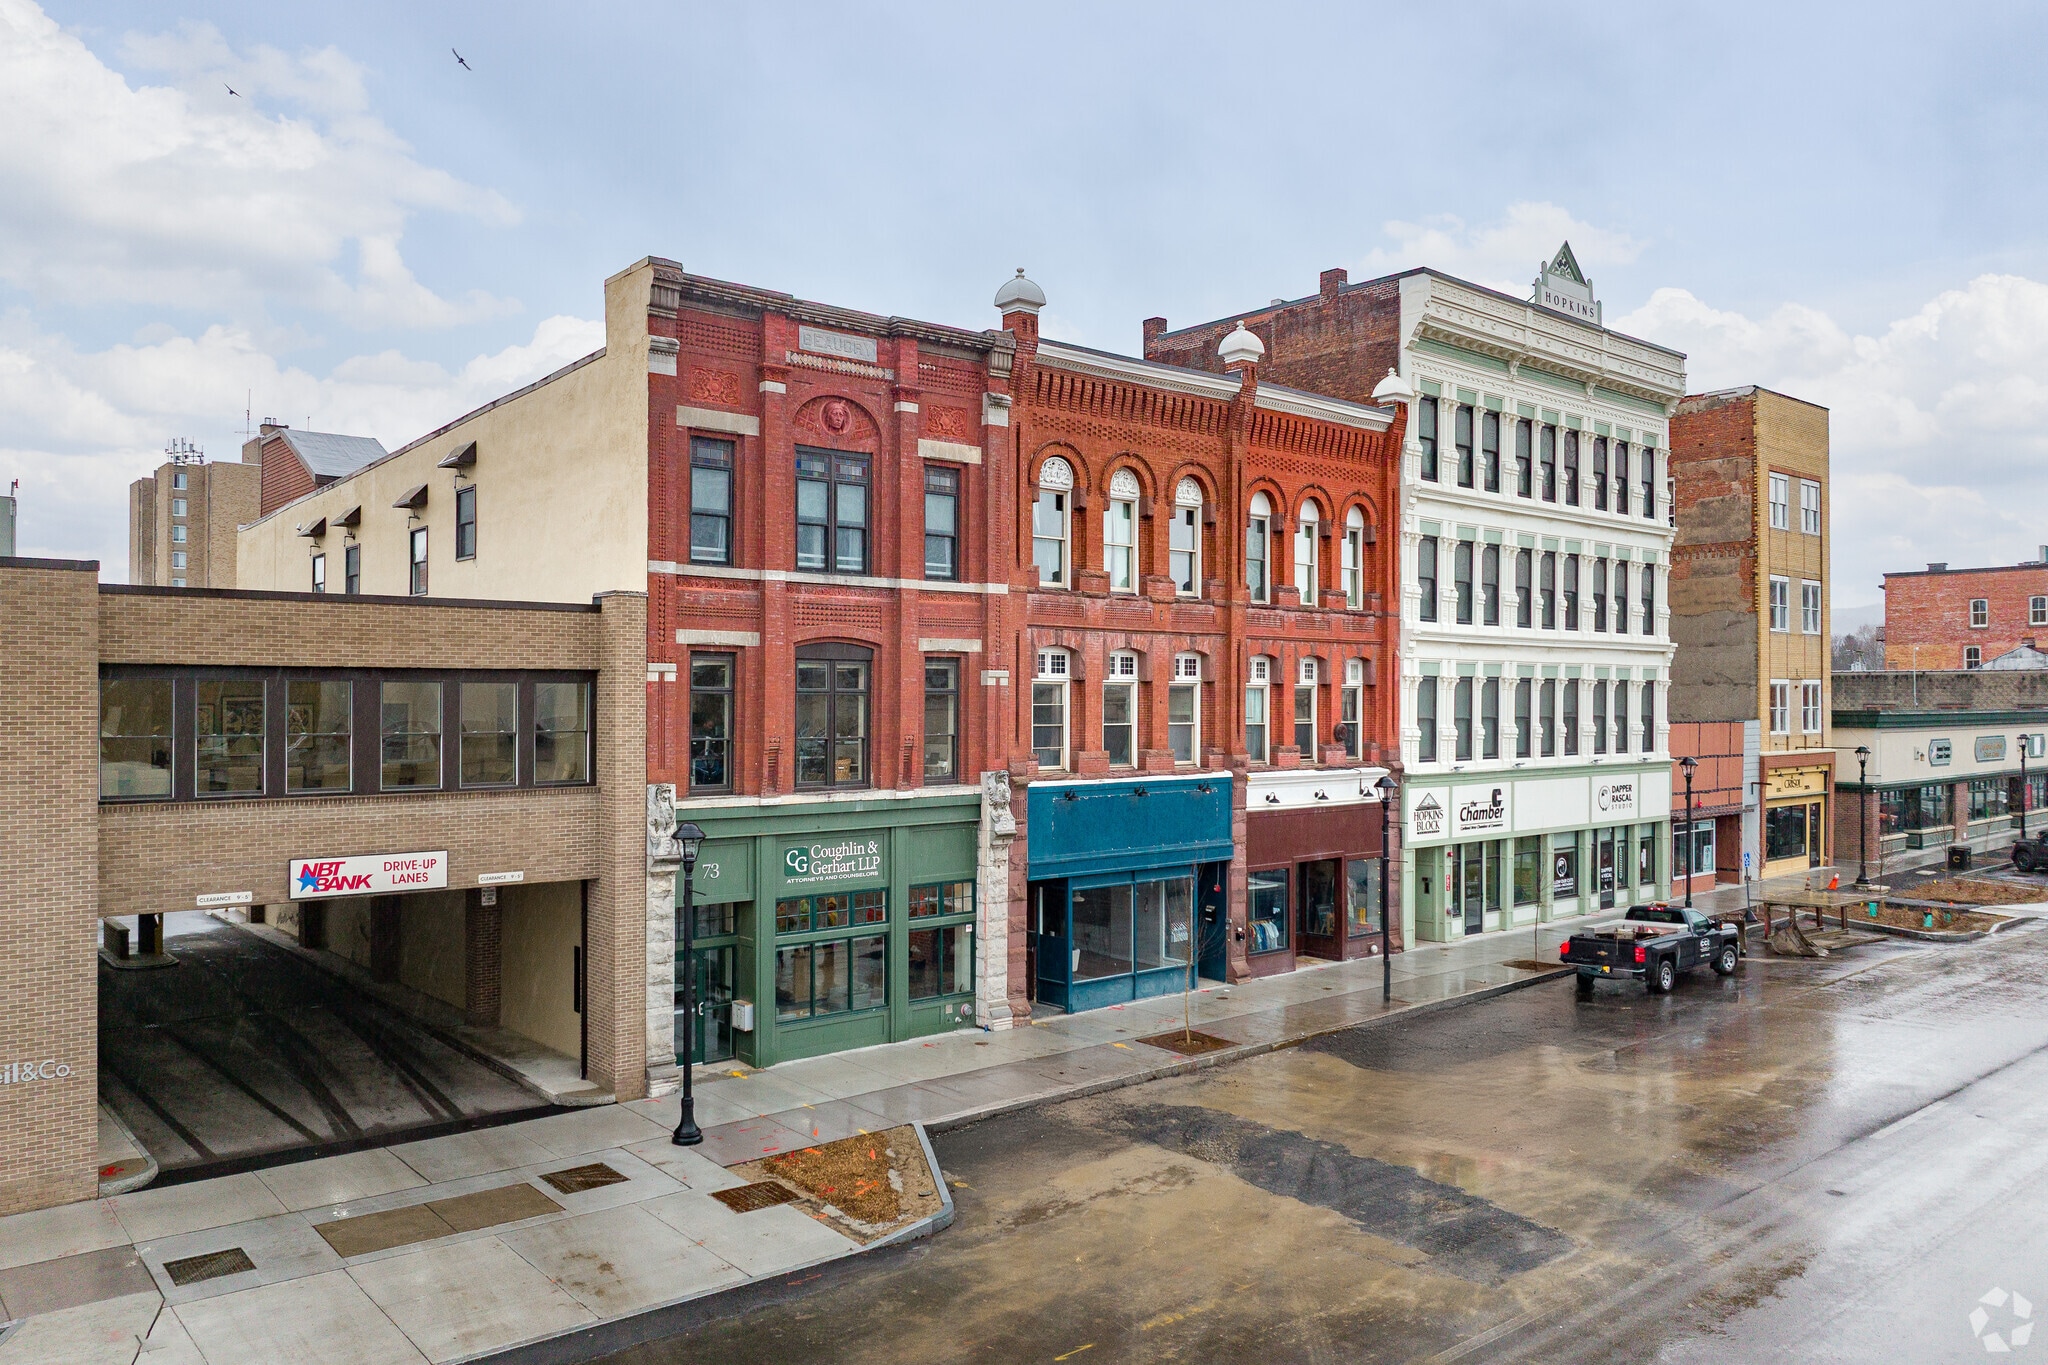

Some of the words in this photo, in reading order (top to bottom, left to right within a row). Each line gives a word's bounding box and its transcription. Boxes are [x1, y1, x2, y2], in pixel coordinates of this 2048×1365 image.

[1545, 291, 1595, 318] HOPKINS
[803, 332, 872, 357] BEAUDRY
[1611, 784, 1633, 794] DAPPER
[1611, 794, 1632, 803] RASCAL
[1611, 802, 1633, 810] STUDIO
[1413, 809, 1444, 822] HOPKINS
[1460, 804, 1505, 822] Chamber
[1416, 820, 1441, 832] BLOCK
[811, 841, 865, 861] Coughlin
[867, 840, 878, 854] &
[383, 858, 437, 872] DRIVE-UP
[786, 850, 808, 872] CG
[811, 859, 856, 875] Gerhart
[858, 856, 880, 871] LLP
[300, 861, 346, 878] NBT
[702, 862, 720, 880] 73
[312, 873, 374, 893] BANK
[392, 871, 429, 885] LANES
[786, 876, 824, 885] ATTORNEYS
[838, 871, 879, 880] COUNSELORS
[199, 895, 231, 903] CLEARANCE
